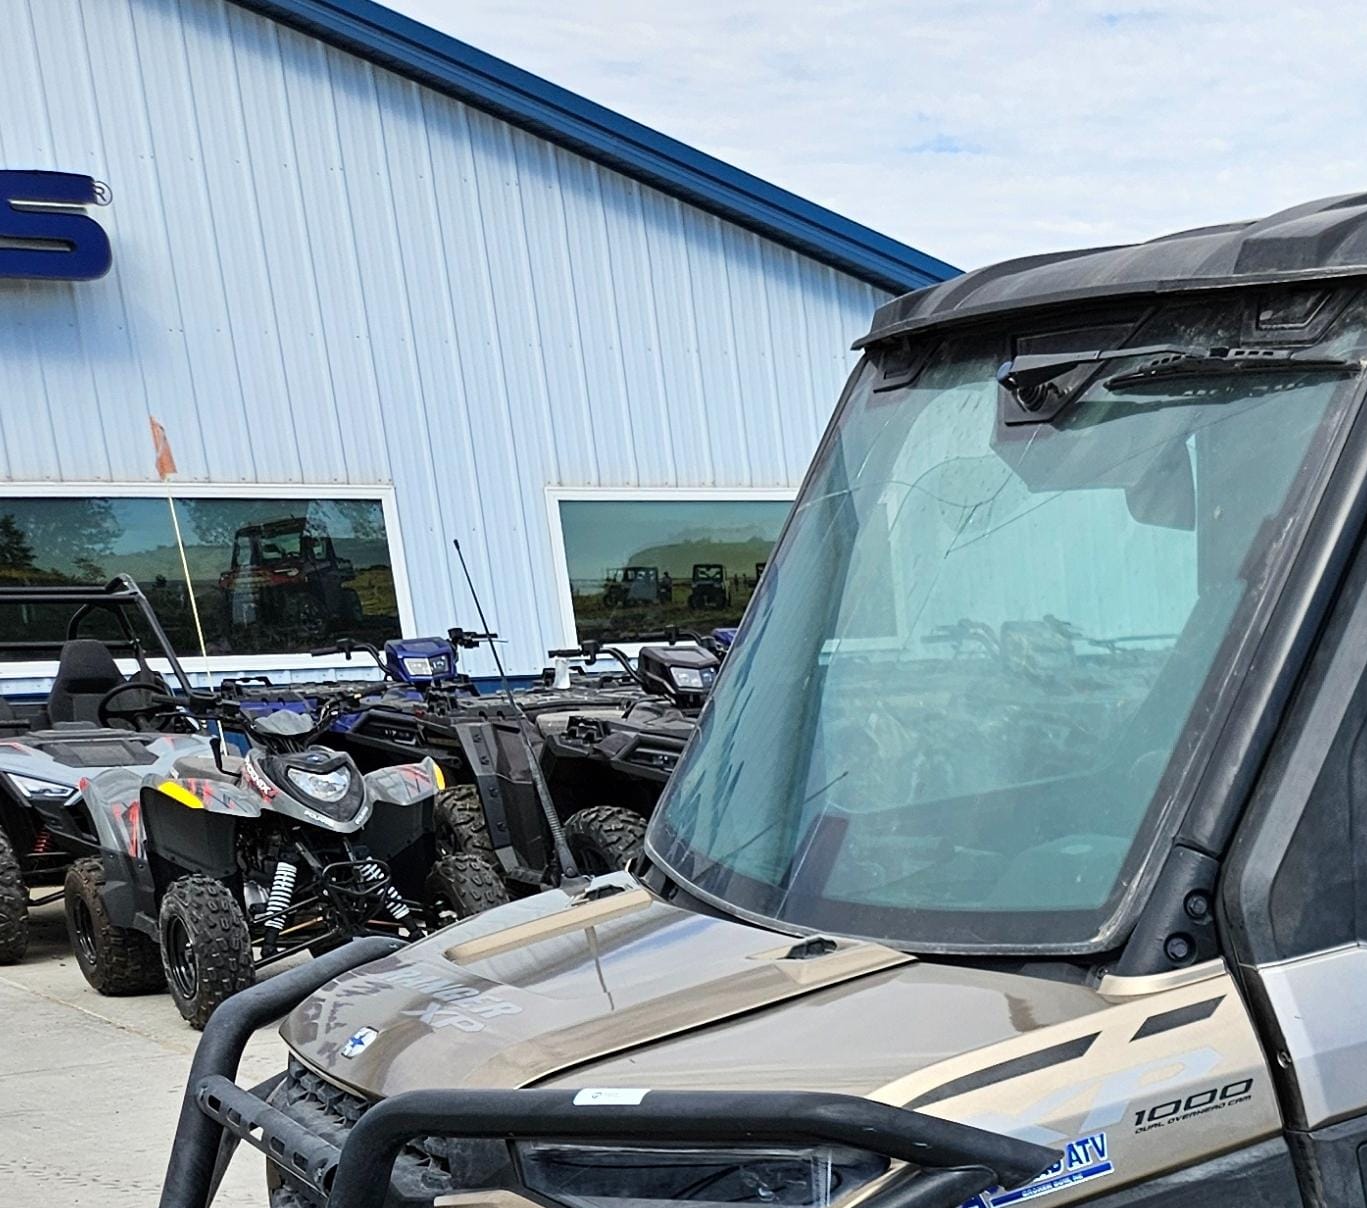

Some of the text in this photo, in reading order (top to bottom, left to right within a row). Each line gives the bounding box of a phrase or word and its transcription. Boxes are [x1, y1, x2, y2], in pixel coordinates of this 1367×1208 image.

[381, 968, 523, 1020] RANGER
[401, 1001, 486, 1033] XP
[1134, 1077, 1253, 1127] 1000
[1134, 1094, 1253, 1135] DUAL OVERHEAD CAM
[1066, 1132, 1105, 1169] ATV
